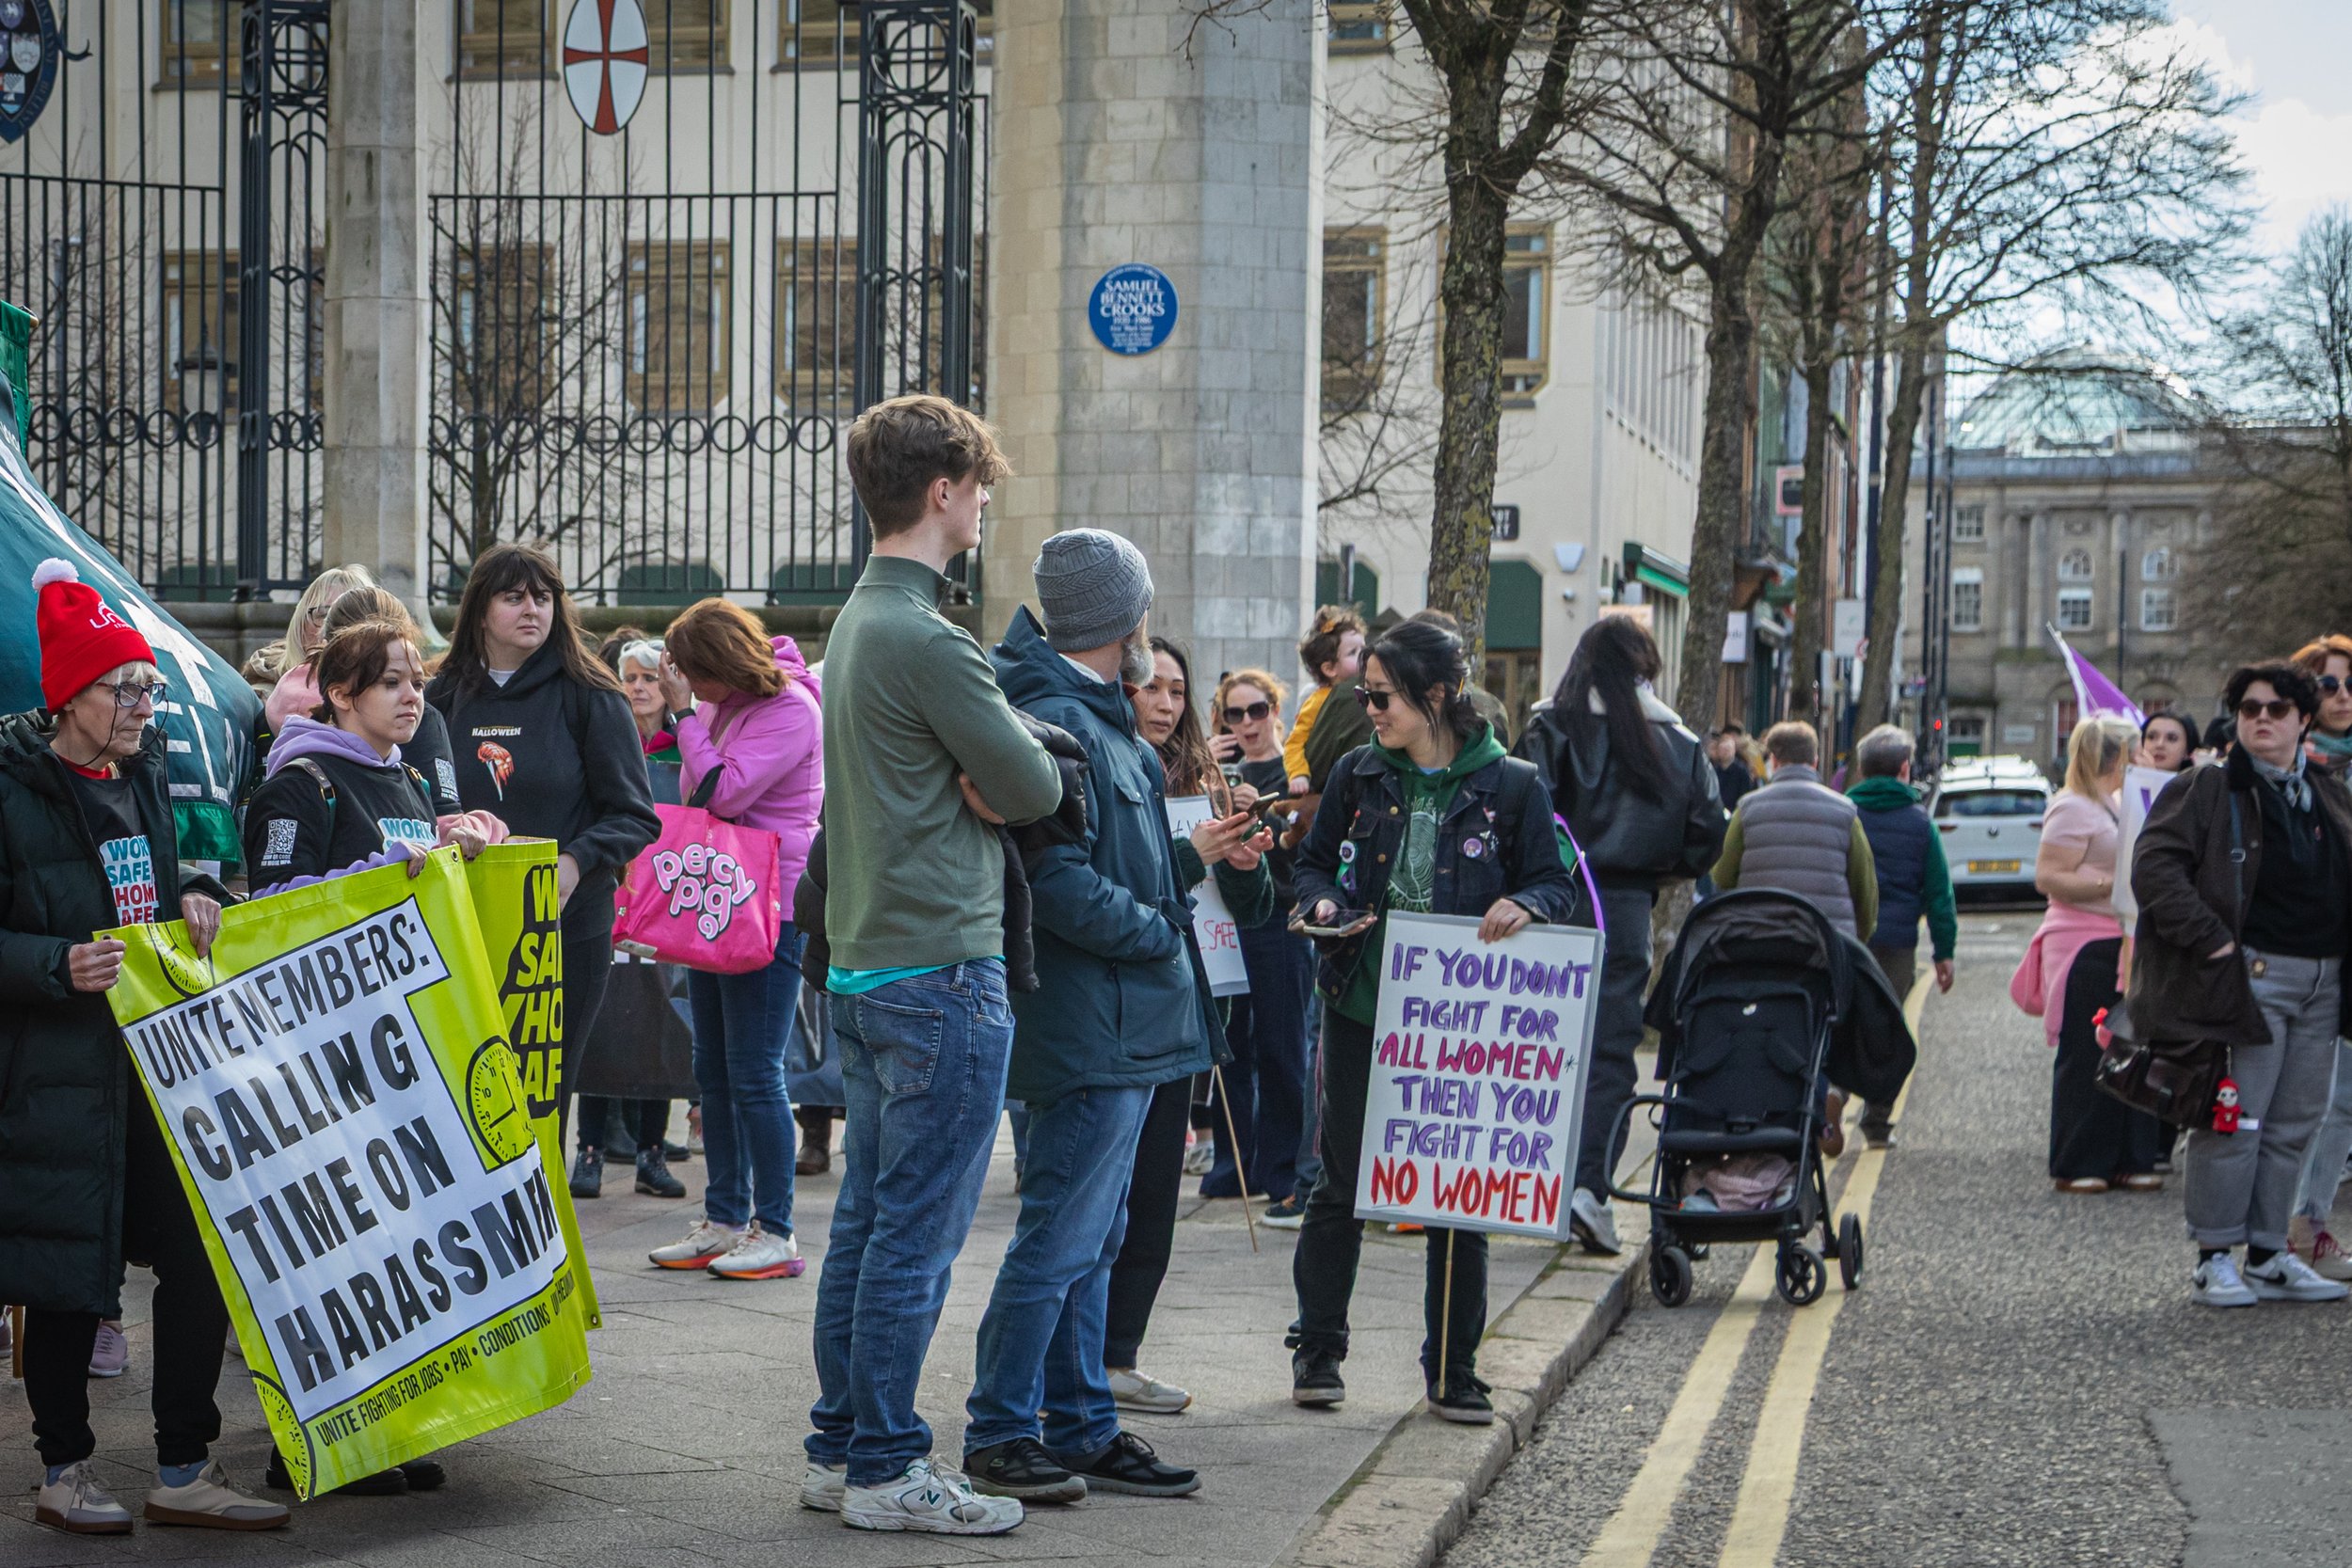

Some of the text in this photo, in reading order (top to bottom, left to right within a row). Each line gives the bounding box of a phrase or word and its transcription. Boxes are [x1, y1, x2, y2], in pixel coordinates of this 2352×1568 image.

[1100, 291, 1165, 304] BENNETT
[1104, 279, 1161, 293] SAMUEL
[1099, 303, 1166, 317] CROOKS
[471, 726, 522, 736] HALLOWEEN
[382, 817, 437, 841] WORK
[104, 861, 151, 886] SAFE
[652, 843, 757, 907] percy
[120, 905, 154, 927] AFE
[1203, 918, 1238, 951] SAFE
[1391, 942, 1593, 999] IF YOU DON'T
[137, 993, 246, 1089] UNITE
[1402, 996, 1559, 1042] FIGHT FOR
[1377, 1031, 1565, 1082] ALL WOMEN
[183, 1013, 421, 1181] CALLING
[1391, 1074, 1561, 1127] THEN YOU
[1384, 1118, 1553, 1171] FIGHT FOR
[224, 1114, 456, 1285] TIME ON
[1370, 1154, 1561, 1227] NO WOMEN
[315, 1408, 361, 1447] UNITE
[358, 1384, 402, 1428] FIGHTING
[397, 1373, 422, 1403] FOR
[419, 1360, 444, 1393] JOBS
[450, 1343, 473, 1374] PAY
[478, 1301, 551, 1356] CONDITIONS
[277, 1409, 284, 1421] 2
[289, 1431, 296, 1442] 3
